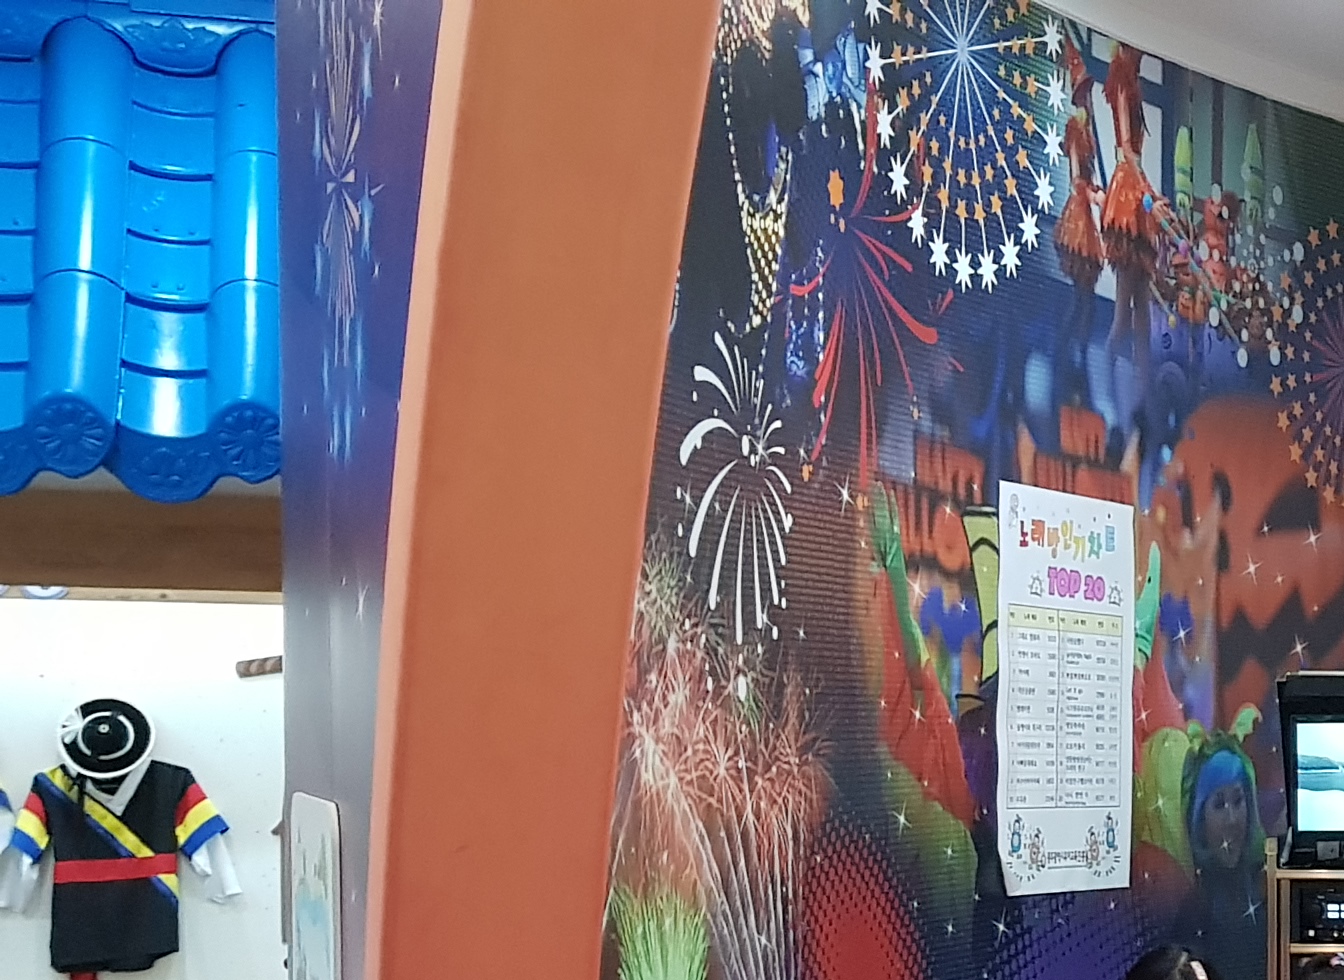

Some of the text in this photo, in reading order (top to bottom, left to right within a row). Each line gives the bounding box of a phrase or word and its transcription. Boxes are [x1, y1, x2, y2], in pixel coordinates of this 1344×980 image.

[1019, 519, 1115, 562] 노래방인기차트
[1047, 566, 1106, 602] TOP 20
